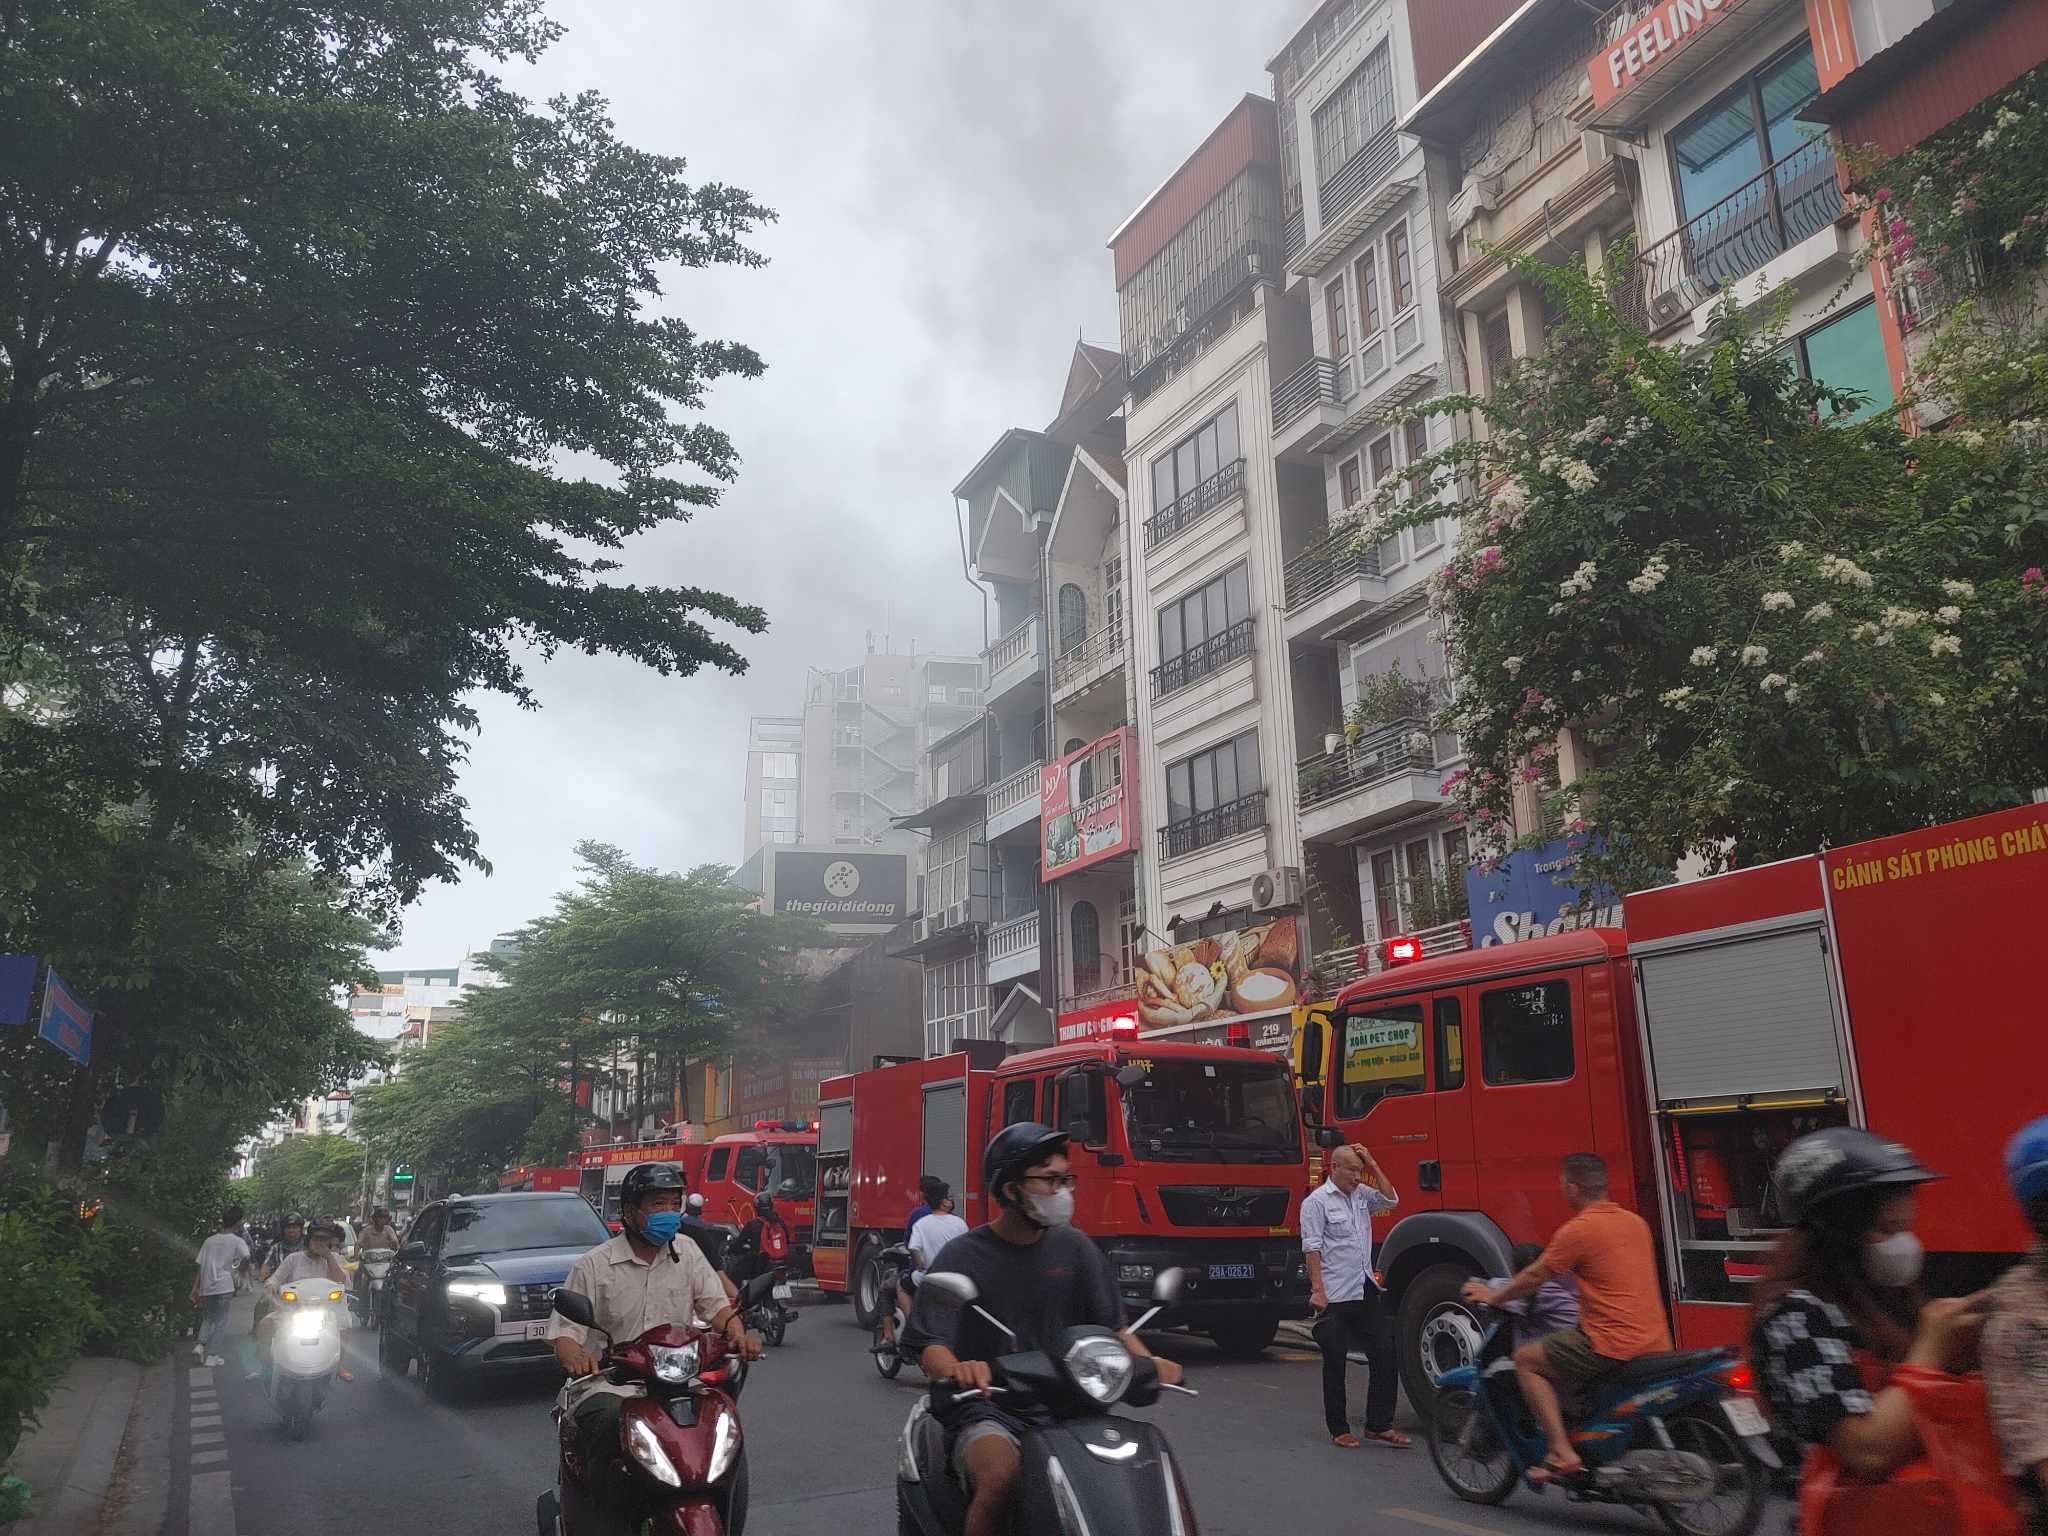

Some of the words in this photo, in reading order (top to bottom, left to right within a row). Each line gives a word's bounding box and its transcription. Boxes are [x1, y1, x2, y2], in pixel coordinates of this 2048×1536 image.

[1608, 0, 1722, 88] FEELIN
[1832, 857, 1884, 890] CẢNH
[1886, 848, 1923, 880] SÁT
[1927, 837, 1998, 873] PHÒNG
[785, 899, 896, 916] thegioididong
[1262, 1023, 1279, 1037] 219
[1370, 1031, 1385, 1044] PET
[1388, 1029, 1409, 1042] SHOP
